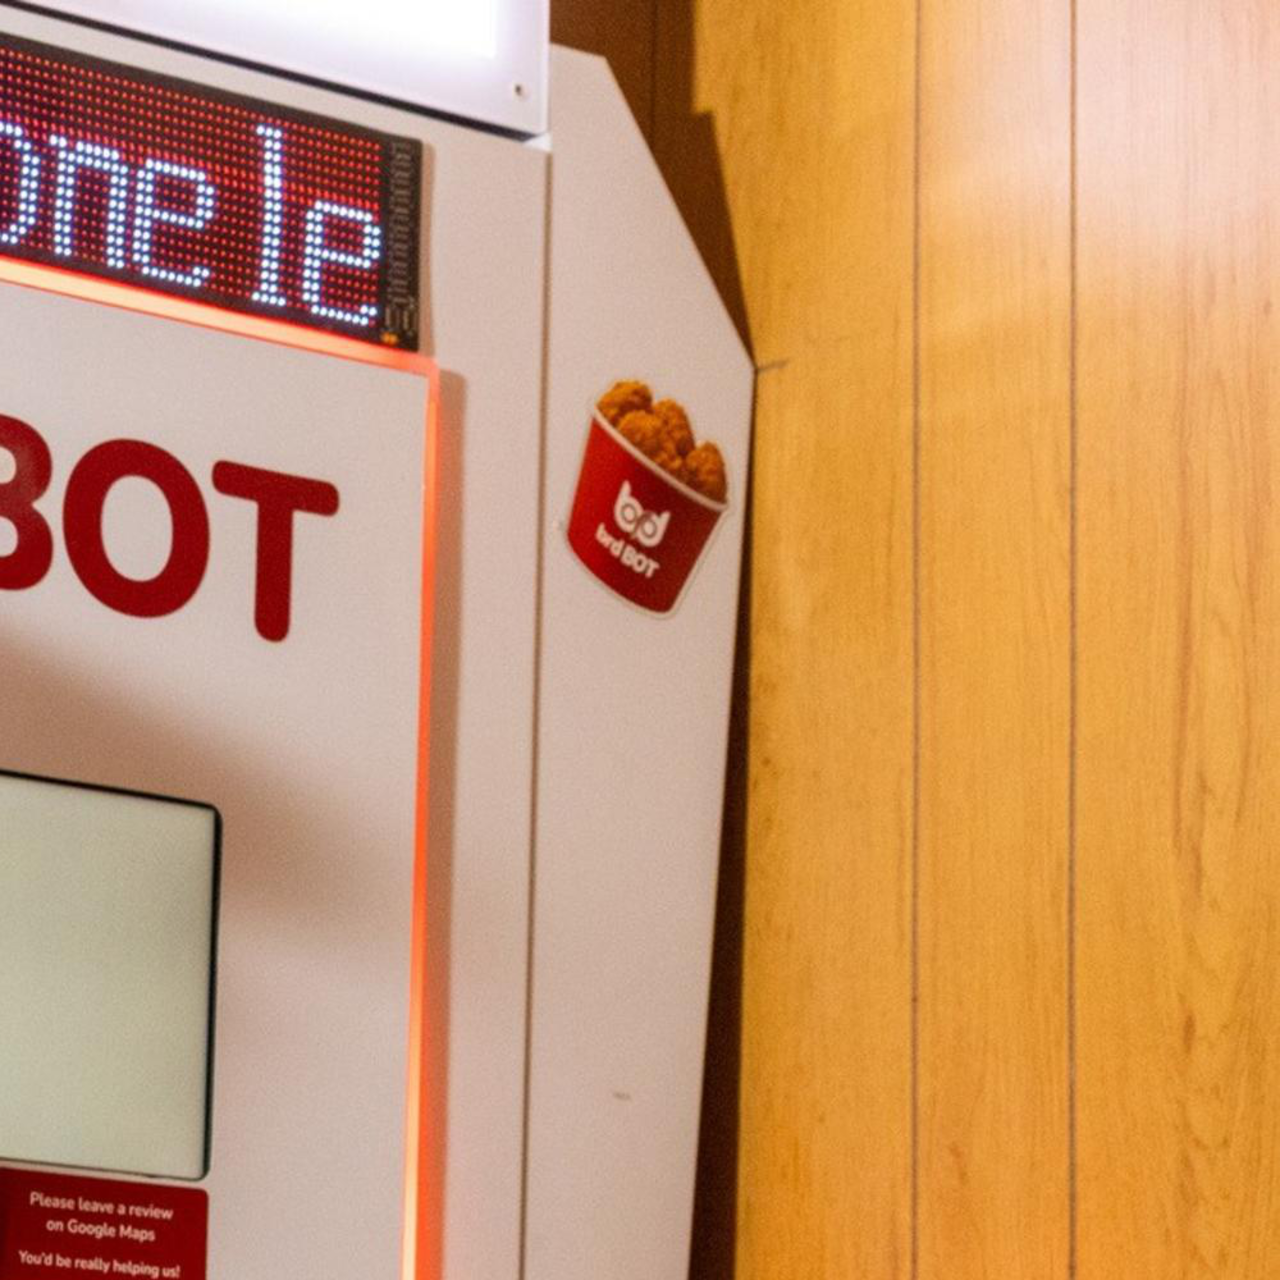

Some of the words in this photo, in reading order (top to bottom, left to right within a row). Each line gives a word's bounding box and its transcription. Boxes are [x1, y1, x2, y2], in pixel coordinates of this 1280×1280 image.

[594, 522, 627, 559] brd
[620, 544, 660, 579] BOT
[29, 1191, 75, 1211] Please
[78, 1196, 114, 1214] leave
[117, 1204, 126, 1216] a
[128, 1204, 174, 1220] review
[46, 1220, 64, 1232] on
[67, 1218, 116, 1240] Google
[119, 1224, 156, 1243] Maps
[18, 1249, 53, 1266] You'd
[55, 1253, 72, 1268] be
[74, 1256, 111, 1274] really
[112, 1259, 159, 1280] helping
[161, 1264, 181, 1279] us!
